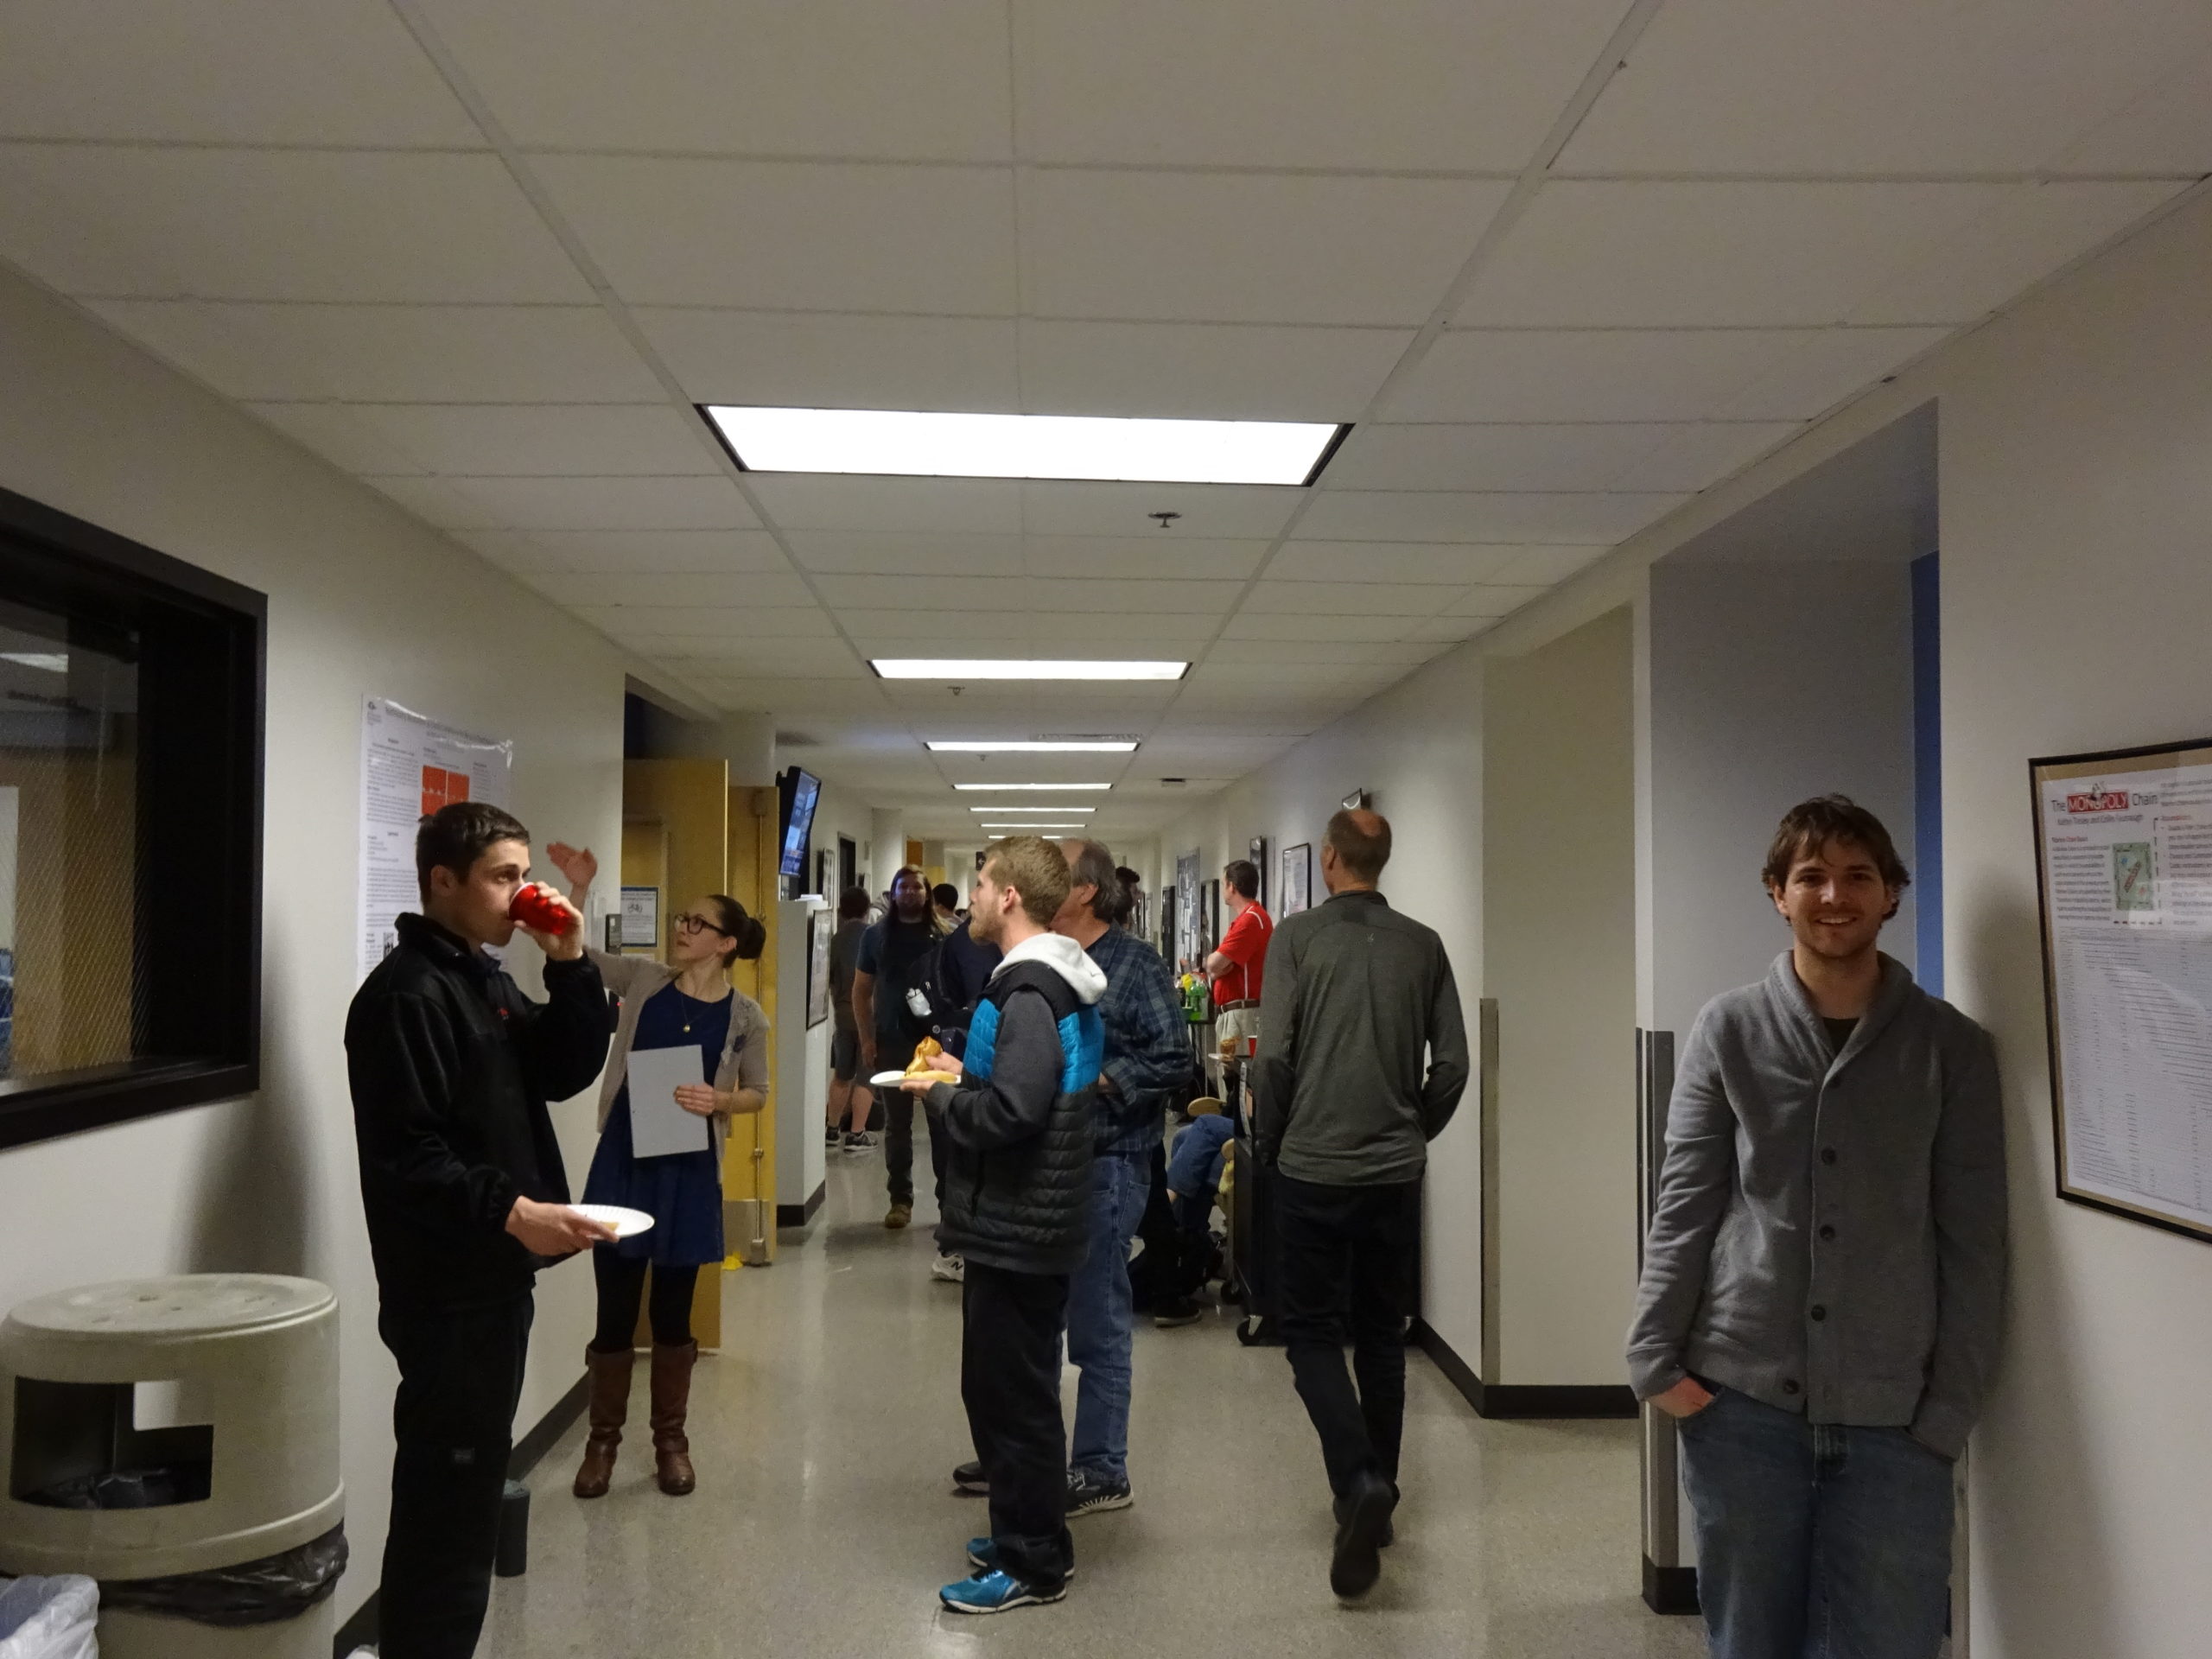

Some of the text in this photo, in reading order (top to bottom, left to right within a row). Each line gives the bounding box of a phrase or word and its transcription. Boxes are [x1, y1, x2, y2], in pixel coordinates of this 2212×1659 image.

[2051, 799, 2066, 812] The
[2068, 793, 2127, 811] MONOPOLY
[2132, 793, 2158, 806] Chain
